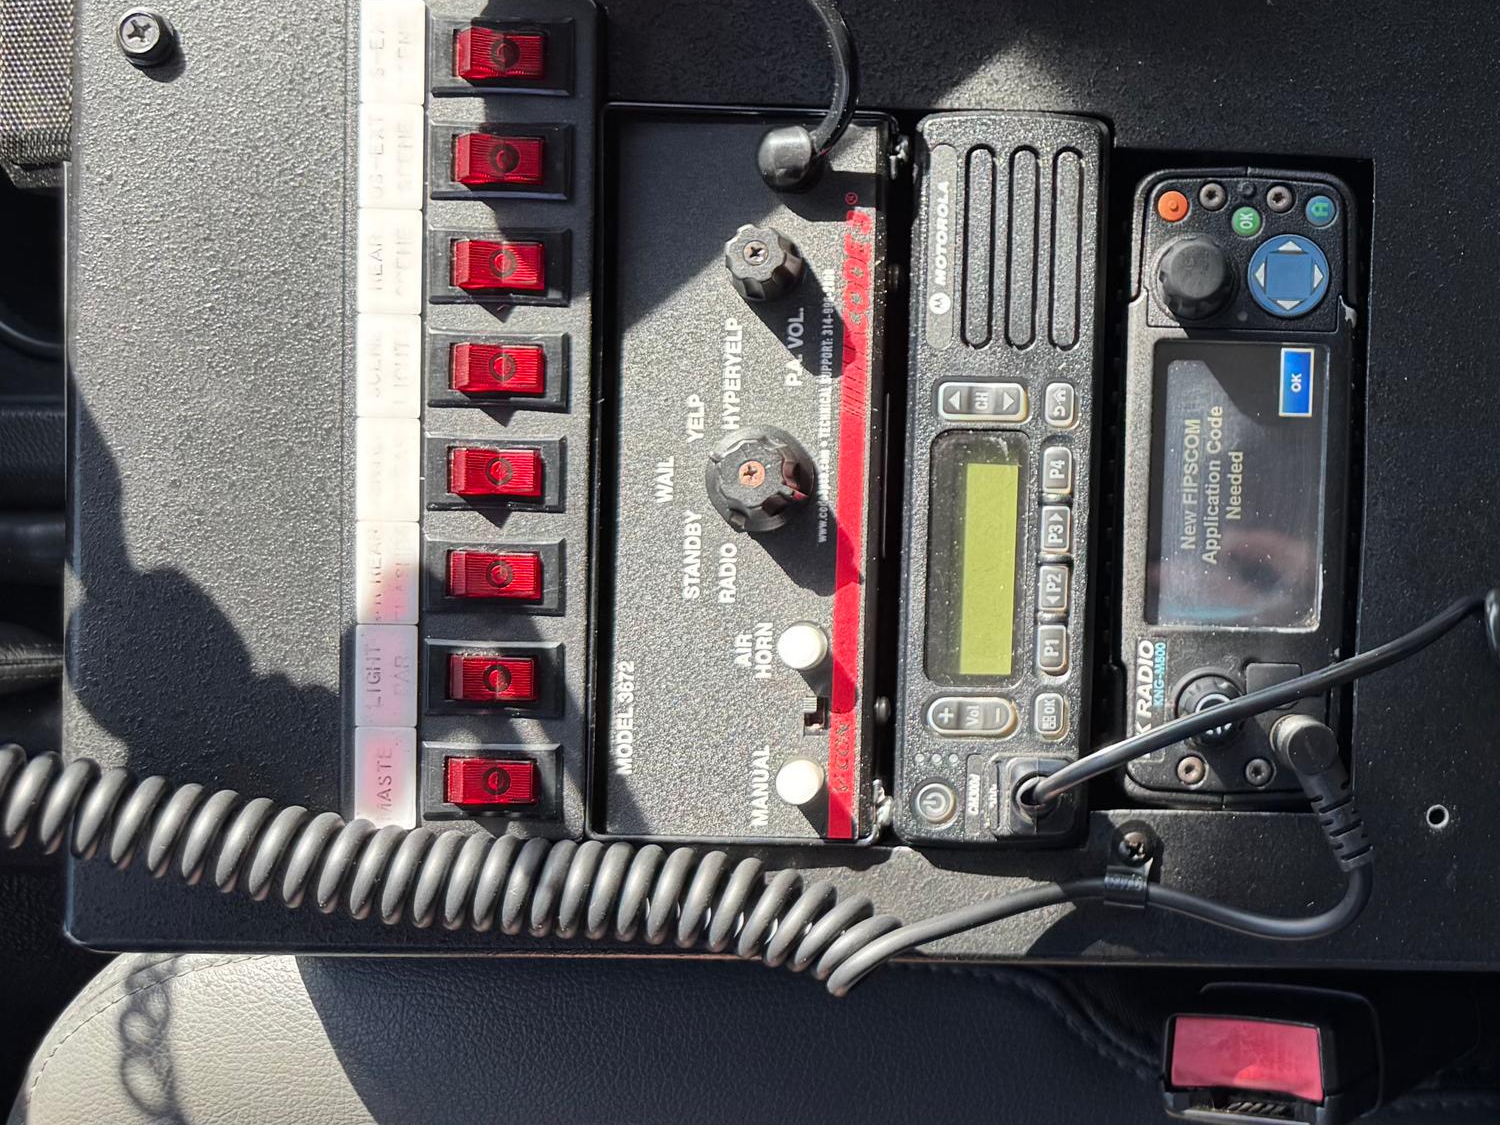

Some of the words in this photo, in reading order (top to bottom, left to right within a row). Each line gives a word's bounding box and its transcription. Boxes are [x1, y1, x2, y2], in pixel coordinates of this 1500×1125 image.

[932, 180, 949, 286] MOTOROLA
[1240, 213, 1254, 229] OK
[843, 234, 871, 332] CODE
[788, 307, 805, 350] VOL.
[722, 317, 743, 430] HYPERYELP
[820, 337, 834, 383] SUPPORT:
[1290, 373, 1302, 393] OK
[687, 393, 705, 444] YELP
[818, 383, 832, 438] TECHNICAL
[975, 391, 989, 410] CH
[1207, 406, 1224, 455] Code
[656, 456, 675, 504] WAIL
[1049, 459, 1065, 479] P4
[1183, 419, 1200, 505] FIPSCOM
[1226, 451, 1243, 521] Needed
[1048, 524, 1064, 543] P3
[1181, 516, 1197, 550] New
[1202, 459, 1222, 565] Application
[683, 510, 703, 600] STANDBY
[718, 542, 738, 604] RADIO
[1046, 573, 1062, 592] P2
[734, 632, 753, 667] AIR
[754, 622, 773, 679] HORN
[1043, 638, 1060, 658] P1
[365, 643, 382, 709] LIGHT
[617, 661, 635, 703] 3672
[1136, 640, 1155, 718] RADIO
[1153, 641, 1167, 707] KNG-M800
[966, 705, 981, 726] Vol
[1043, 699, 1056, 710] OK
[616, 704, 633, 774] MODEL
[751, 745, 770, 826] MANUAL
